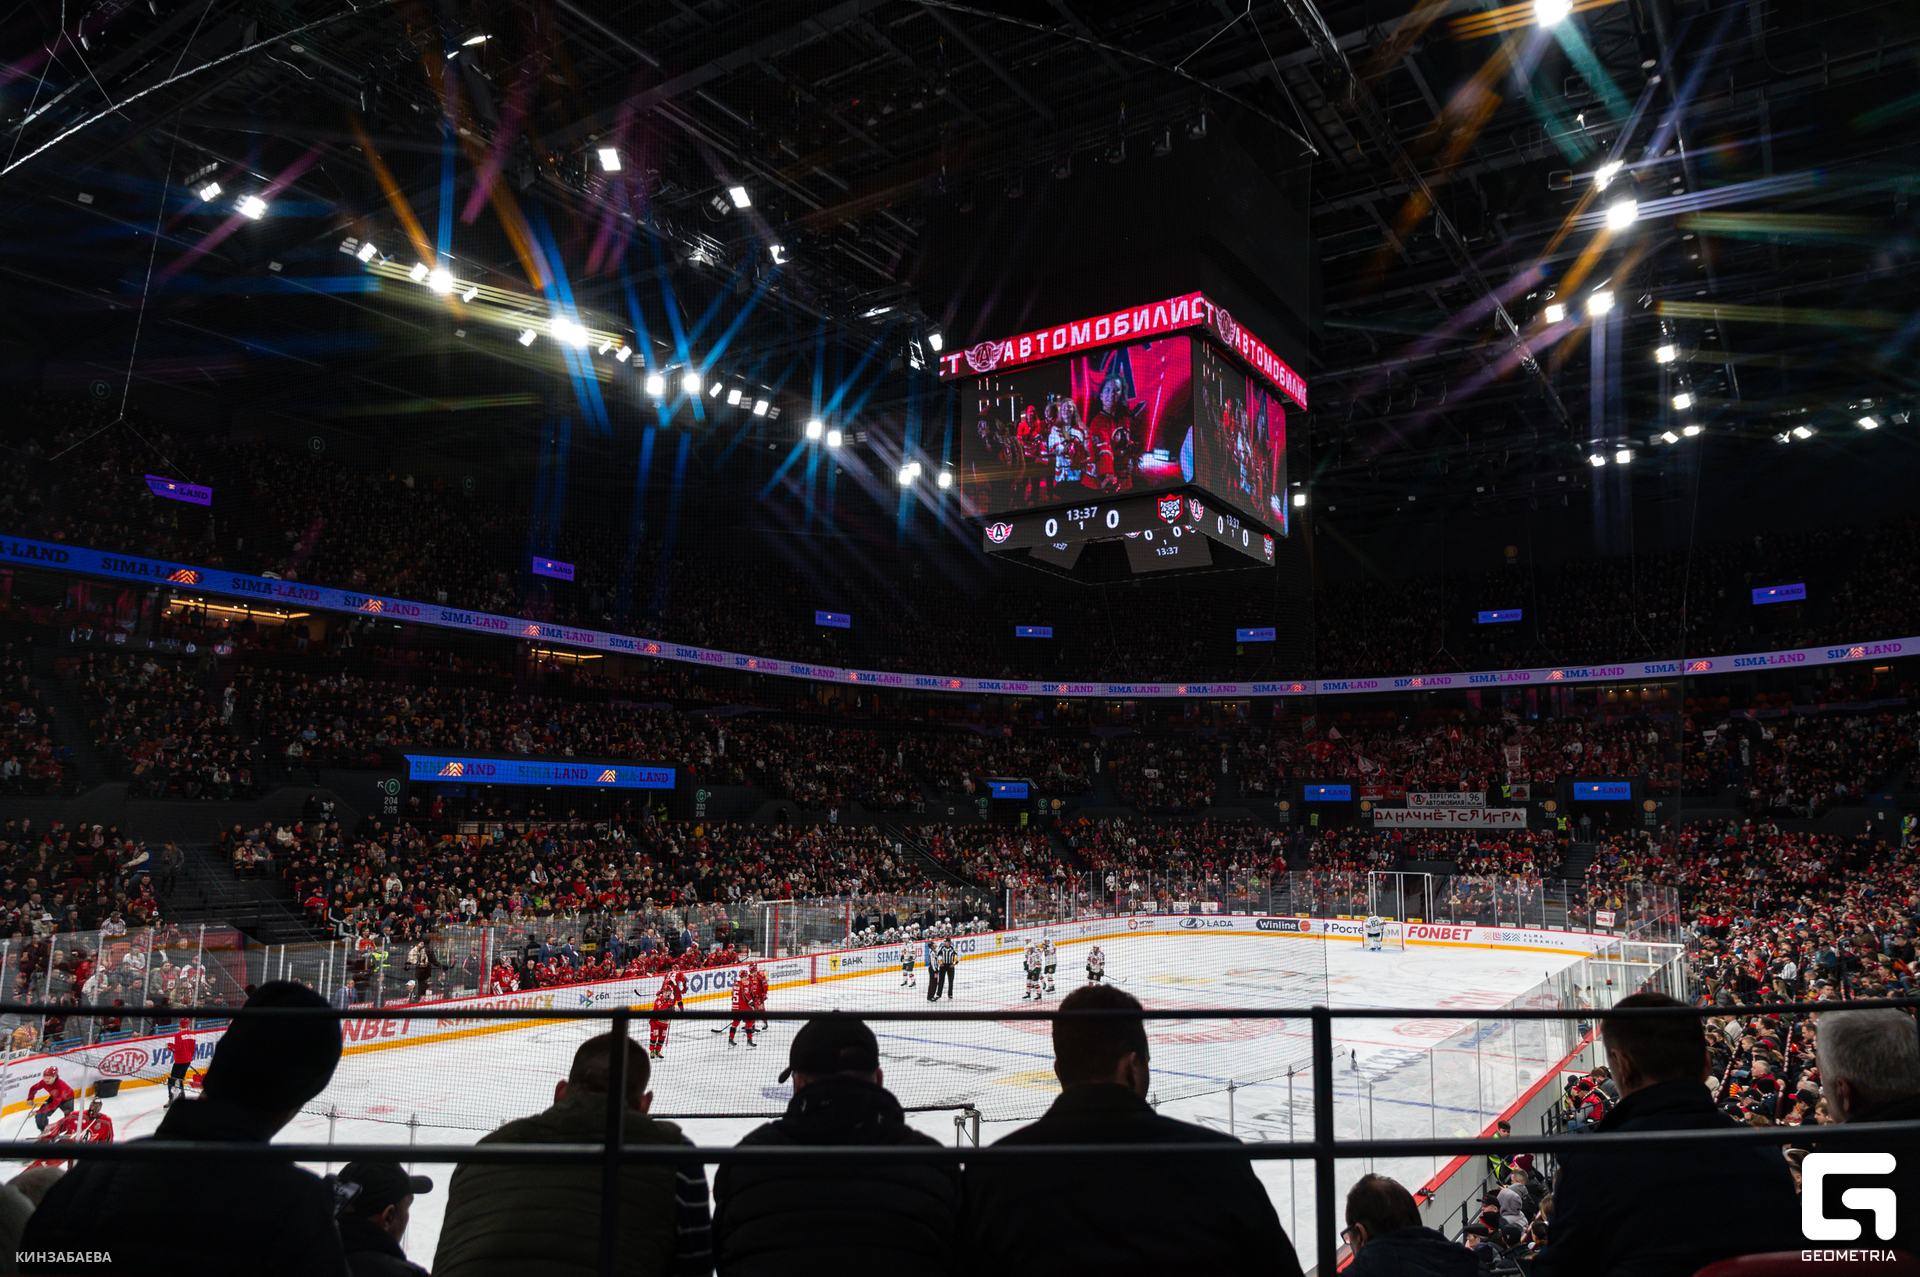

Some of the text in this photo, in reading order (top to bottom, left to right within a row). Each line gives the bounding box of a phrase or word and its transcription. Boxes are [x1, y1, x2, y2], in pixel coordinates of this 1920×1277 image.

[1003, 297, 1214, 362] АВТОМОБИЛИСТ
[1066, 506, 1098, 521] 13:37
[1106, 509, 1120, 529] 0
[1045, 518, 1058, 537] 0
[1078, 521, 1084, 531] 1
[1217, 515, 1224, 535] 0
[1226, 514, 1240, 530] 13:37
[1242, 529, 1249, 547] 0
[1156, 546, 1179, 556] 13:37
[232, 577, 320, 602] SIMA-LAND
[441, 611, 508, 630] SIMA-LAND
[676, 647, 723, 663] SIMA-LAND
[1734, 652, 1805, 667] SIMA-LAND
[790, 665, 835, 678] SIMA-LAND
[1469, 672, 1530, 683] SIMA-LAND
[978, 681, 1028, 692] SIMA-LAND
[1108, 685, 1160, 694] SIMA-LAND
[1322, 680, 1378, 691] SIMA-LAND
[518, 766, 589, 780] SIMA-LAND
[384, 797, 399, 805] 204
[1469, 793, 1480, 801] 96
[1375, 811, 1393, 820] ДА
[1483, 808, 1521, 823] ИГРА
[1206, 920, 1233, 928] LADA
[1260, 920, 1297, 930] Winline
[1408, 926, 1473, 941] FONBET
[842, 956, 863, 967] БАНК
[686, 970, 738, 993] огаз
